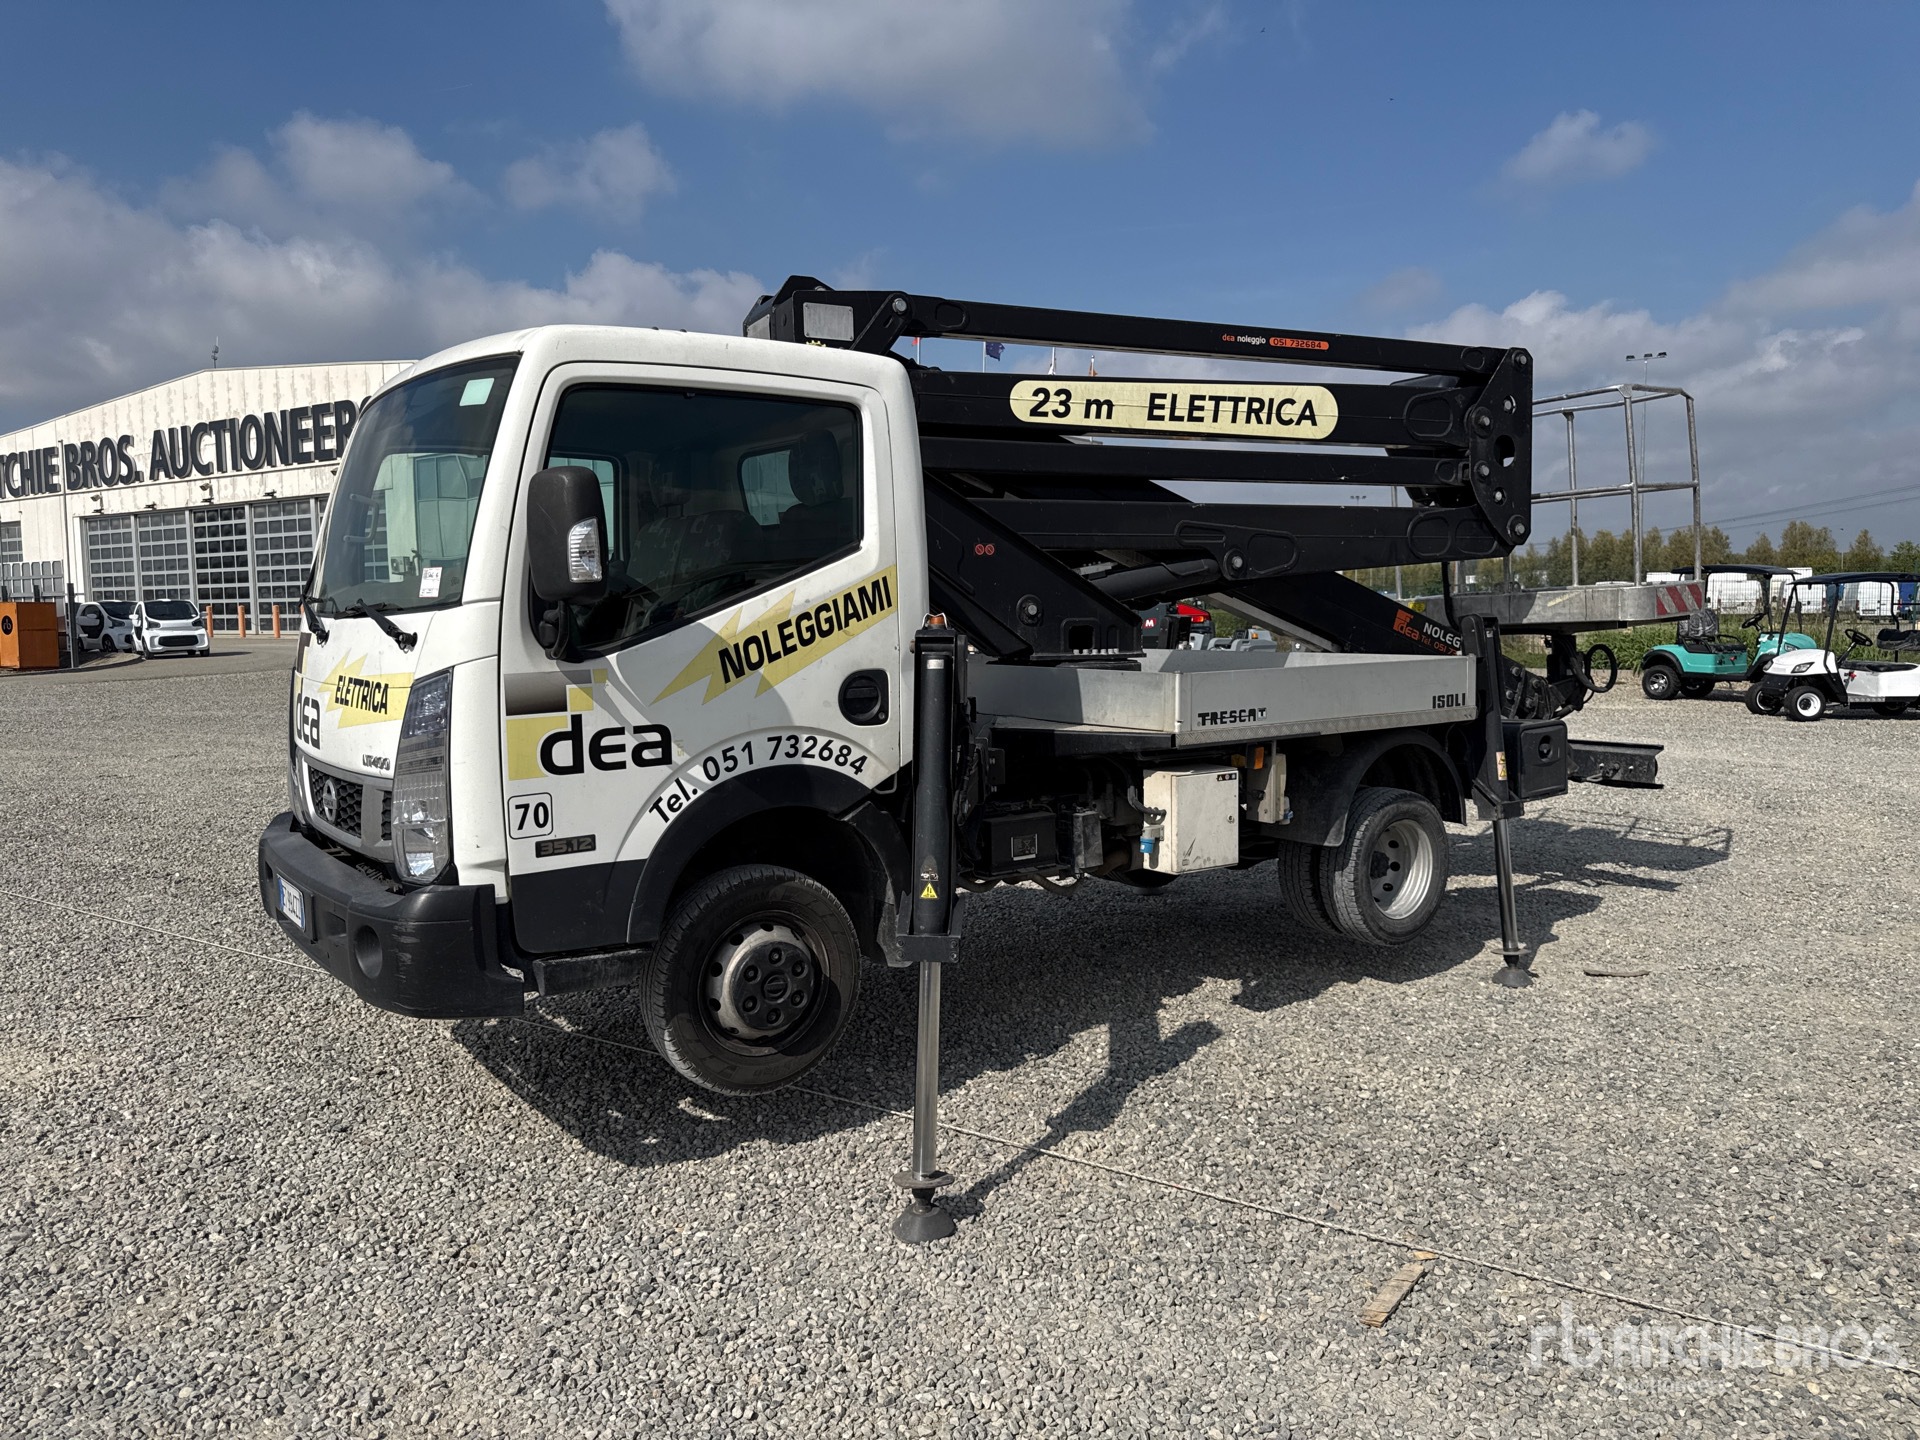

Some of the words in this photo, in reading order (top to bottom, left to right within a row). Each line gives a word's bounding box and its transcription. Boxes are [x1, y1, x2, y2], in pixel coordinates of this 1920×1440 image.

[1222, 334, 1235, 342] dea
[1237, 335, 1266, 345] noleggio
[1273, 338, 1287, 346] 051
[1290, 339, 1322, 349] 732684
[1029, 387, 1071, 418] 23
[1084, 397, 1114, 420] m
[1147, 393, 1318, 427] ELETTRICA
[64, 436, 144, 491] BROS.
[150, 395, 371, 481] AUCTIONEER
[719, 575, 892, 683] NOLEGGIAMI
[1399, 622, 1420, 640] dea
[334, 675, 389, 715] ELETTRICA
[1432, 693, 1466, 709] ISOLI
[296, 692, 321, 750] dea
[540, 714, 673, 776] dea
[649, 777, 698, 823] Tel.
[703, 741, 754, 781] 051
[765, 735, 868, 775] 732684
[514, 802, 550, 831] 70
[540, 837, 592, 856] 35.12
